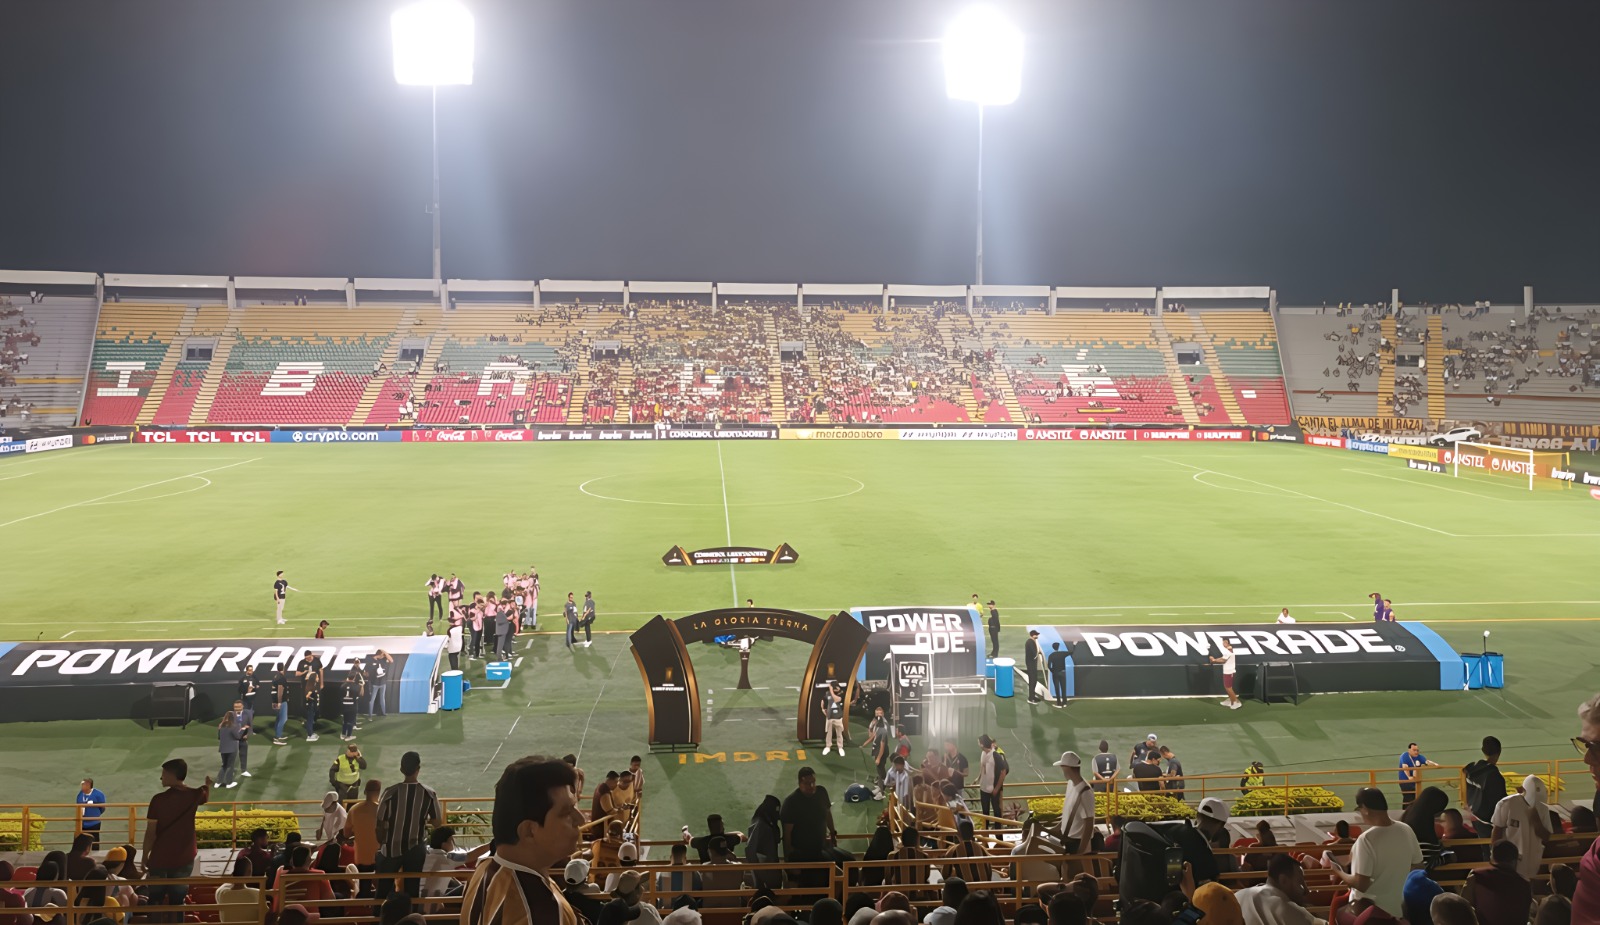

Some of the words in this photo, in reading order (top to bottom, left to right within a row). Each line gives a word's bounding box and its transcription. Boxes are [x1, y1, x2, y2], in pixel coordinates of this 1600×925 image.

[141, 431, 176, 442] TCL
[186, 431, 221, 442] TCL
[231, 431, 266, 442] TCL
[305, 431, 378, 442] crypto.com
[868, 613, 963, 632] POWER
[12, 645, 375, 676] POWERADE
[903, 665, 925, 675] VAR
[678, 749, 807, 764] IMDRI
